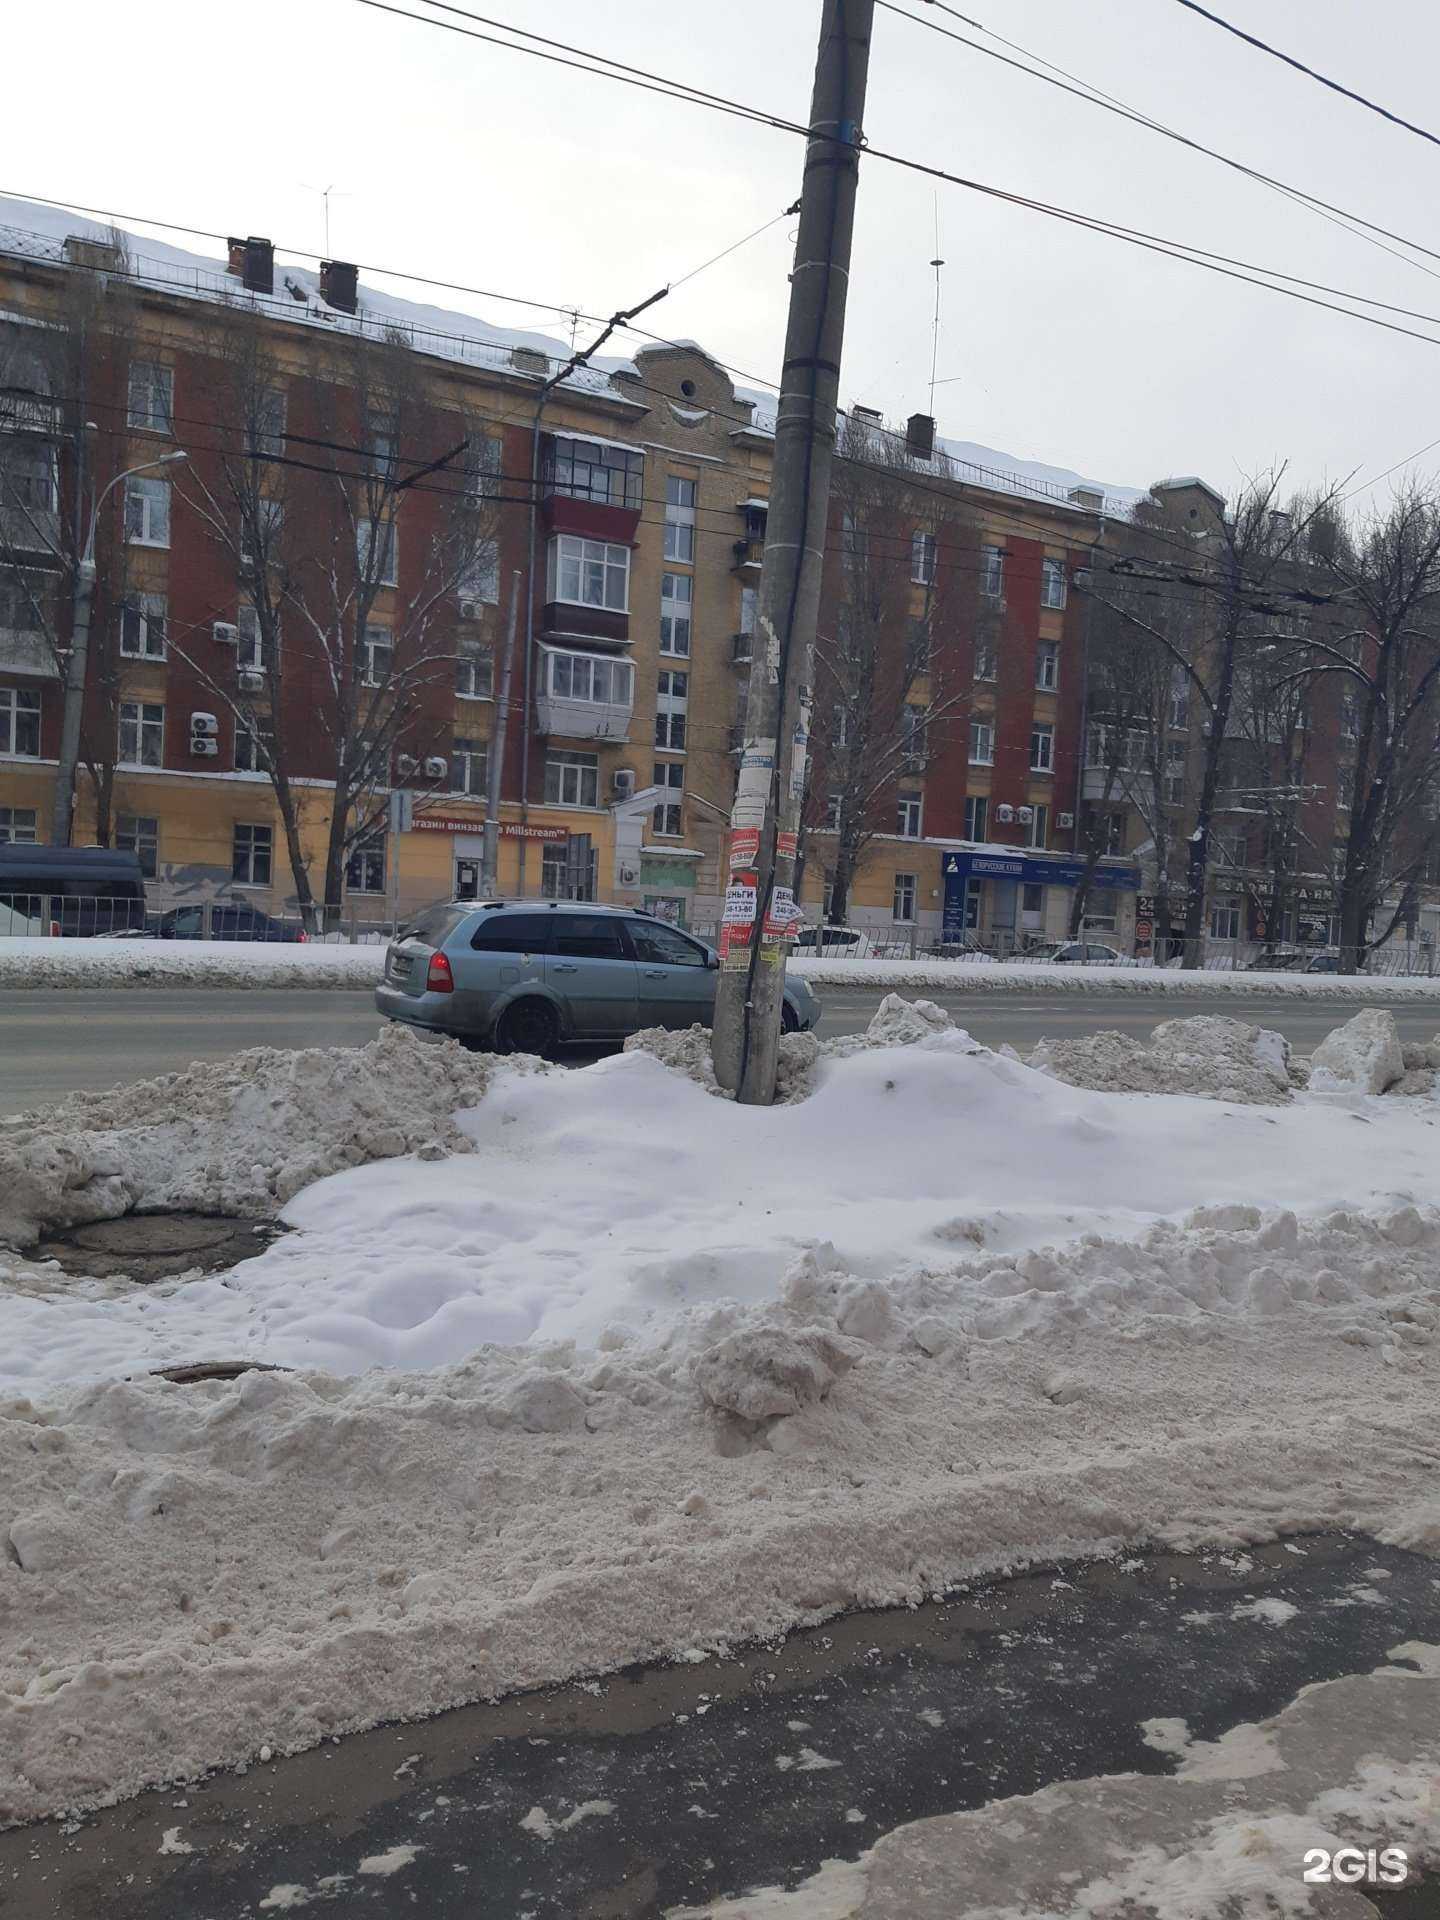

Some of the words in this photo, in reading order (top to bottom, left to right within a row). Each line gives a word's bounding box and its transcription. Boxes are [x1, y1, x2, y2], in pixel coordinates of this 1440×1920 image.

[411, 819, 446, 830] газин
[727, 890, 754, 899] ЕНЬГИ
[1139, 897, 1155, 911] 24
